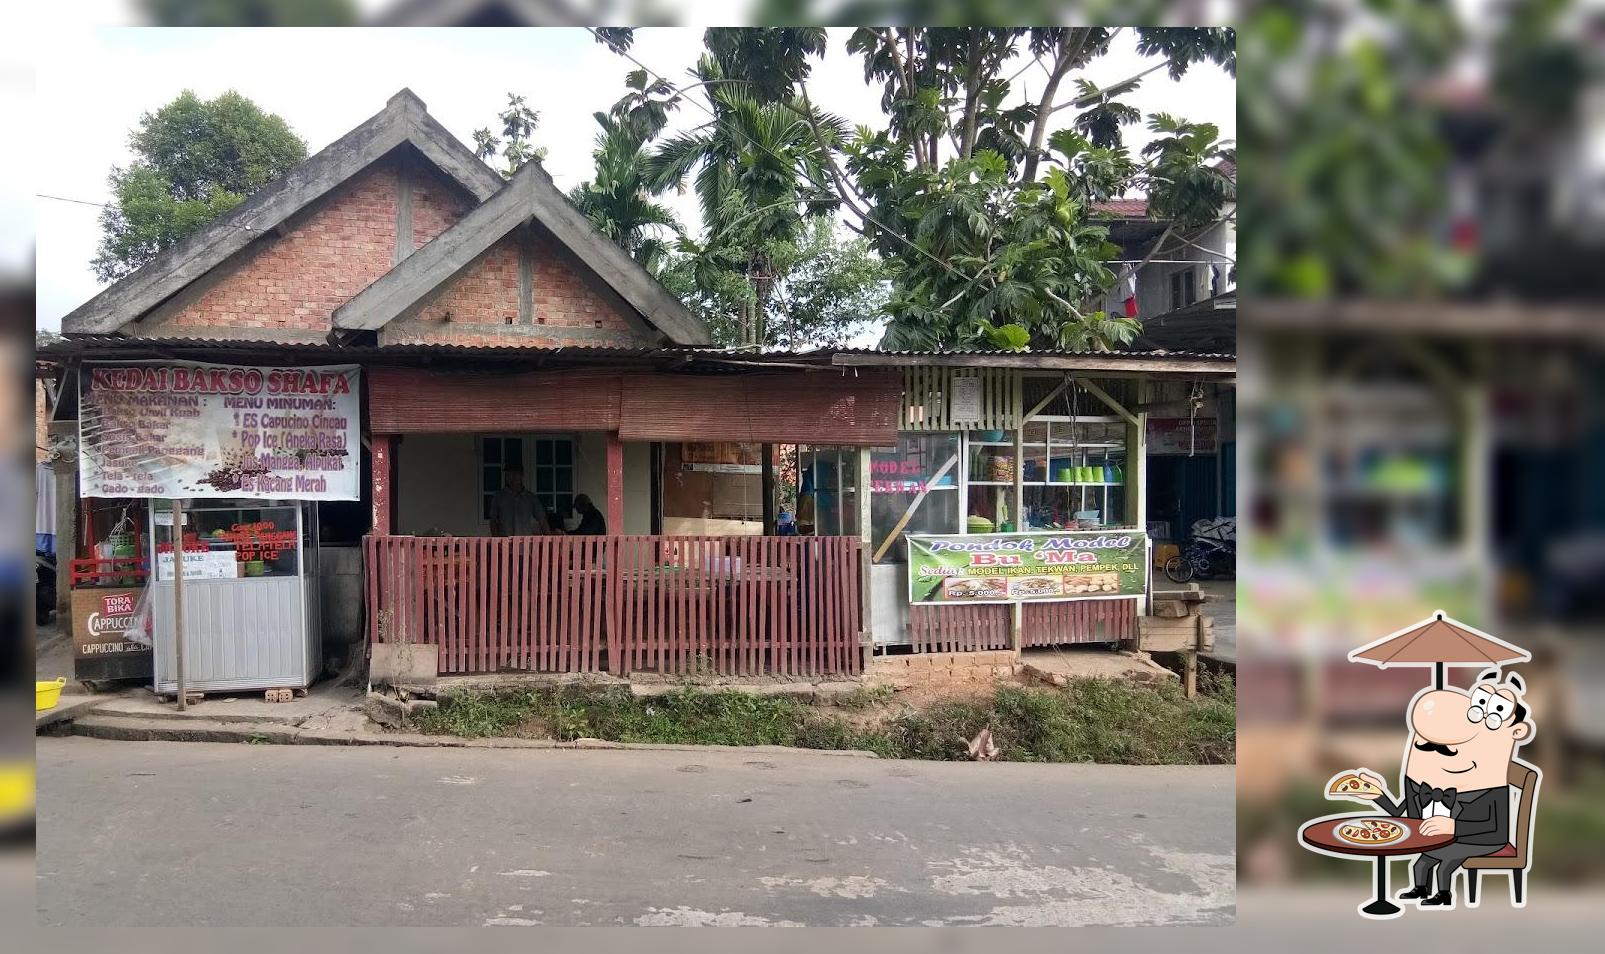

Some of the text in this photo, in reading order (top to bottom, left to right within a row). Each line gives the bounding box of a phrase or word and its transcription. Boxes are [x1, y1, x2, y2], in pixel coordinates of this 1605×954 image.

[92, 368, 350, 394] KEDAI BAKSO SHAFA
[128, 395, 199, 407] MAKANAN
[224, 397, 263, 408] MENU
[241, 431, 260, 448] Pop
[263, 431, 278, 448] Ice
[295, 474, 326, 491] Merah
[102, 484, 128, 493] Gado
[930, 536, 1131, 552] Pondok Model
[162, 555, 205, 563] JAUKE
[235, 551, 279, 560] POP ICE
[970, 553, 1023, 566] Bu
[1122, 563, 1139, 571] DLL
[104, 596, 132, 605] TORA
[107, 604, 132, 613] BIKA
[83, 642, 123, 654] CAPPUCCINO
